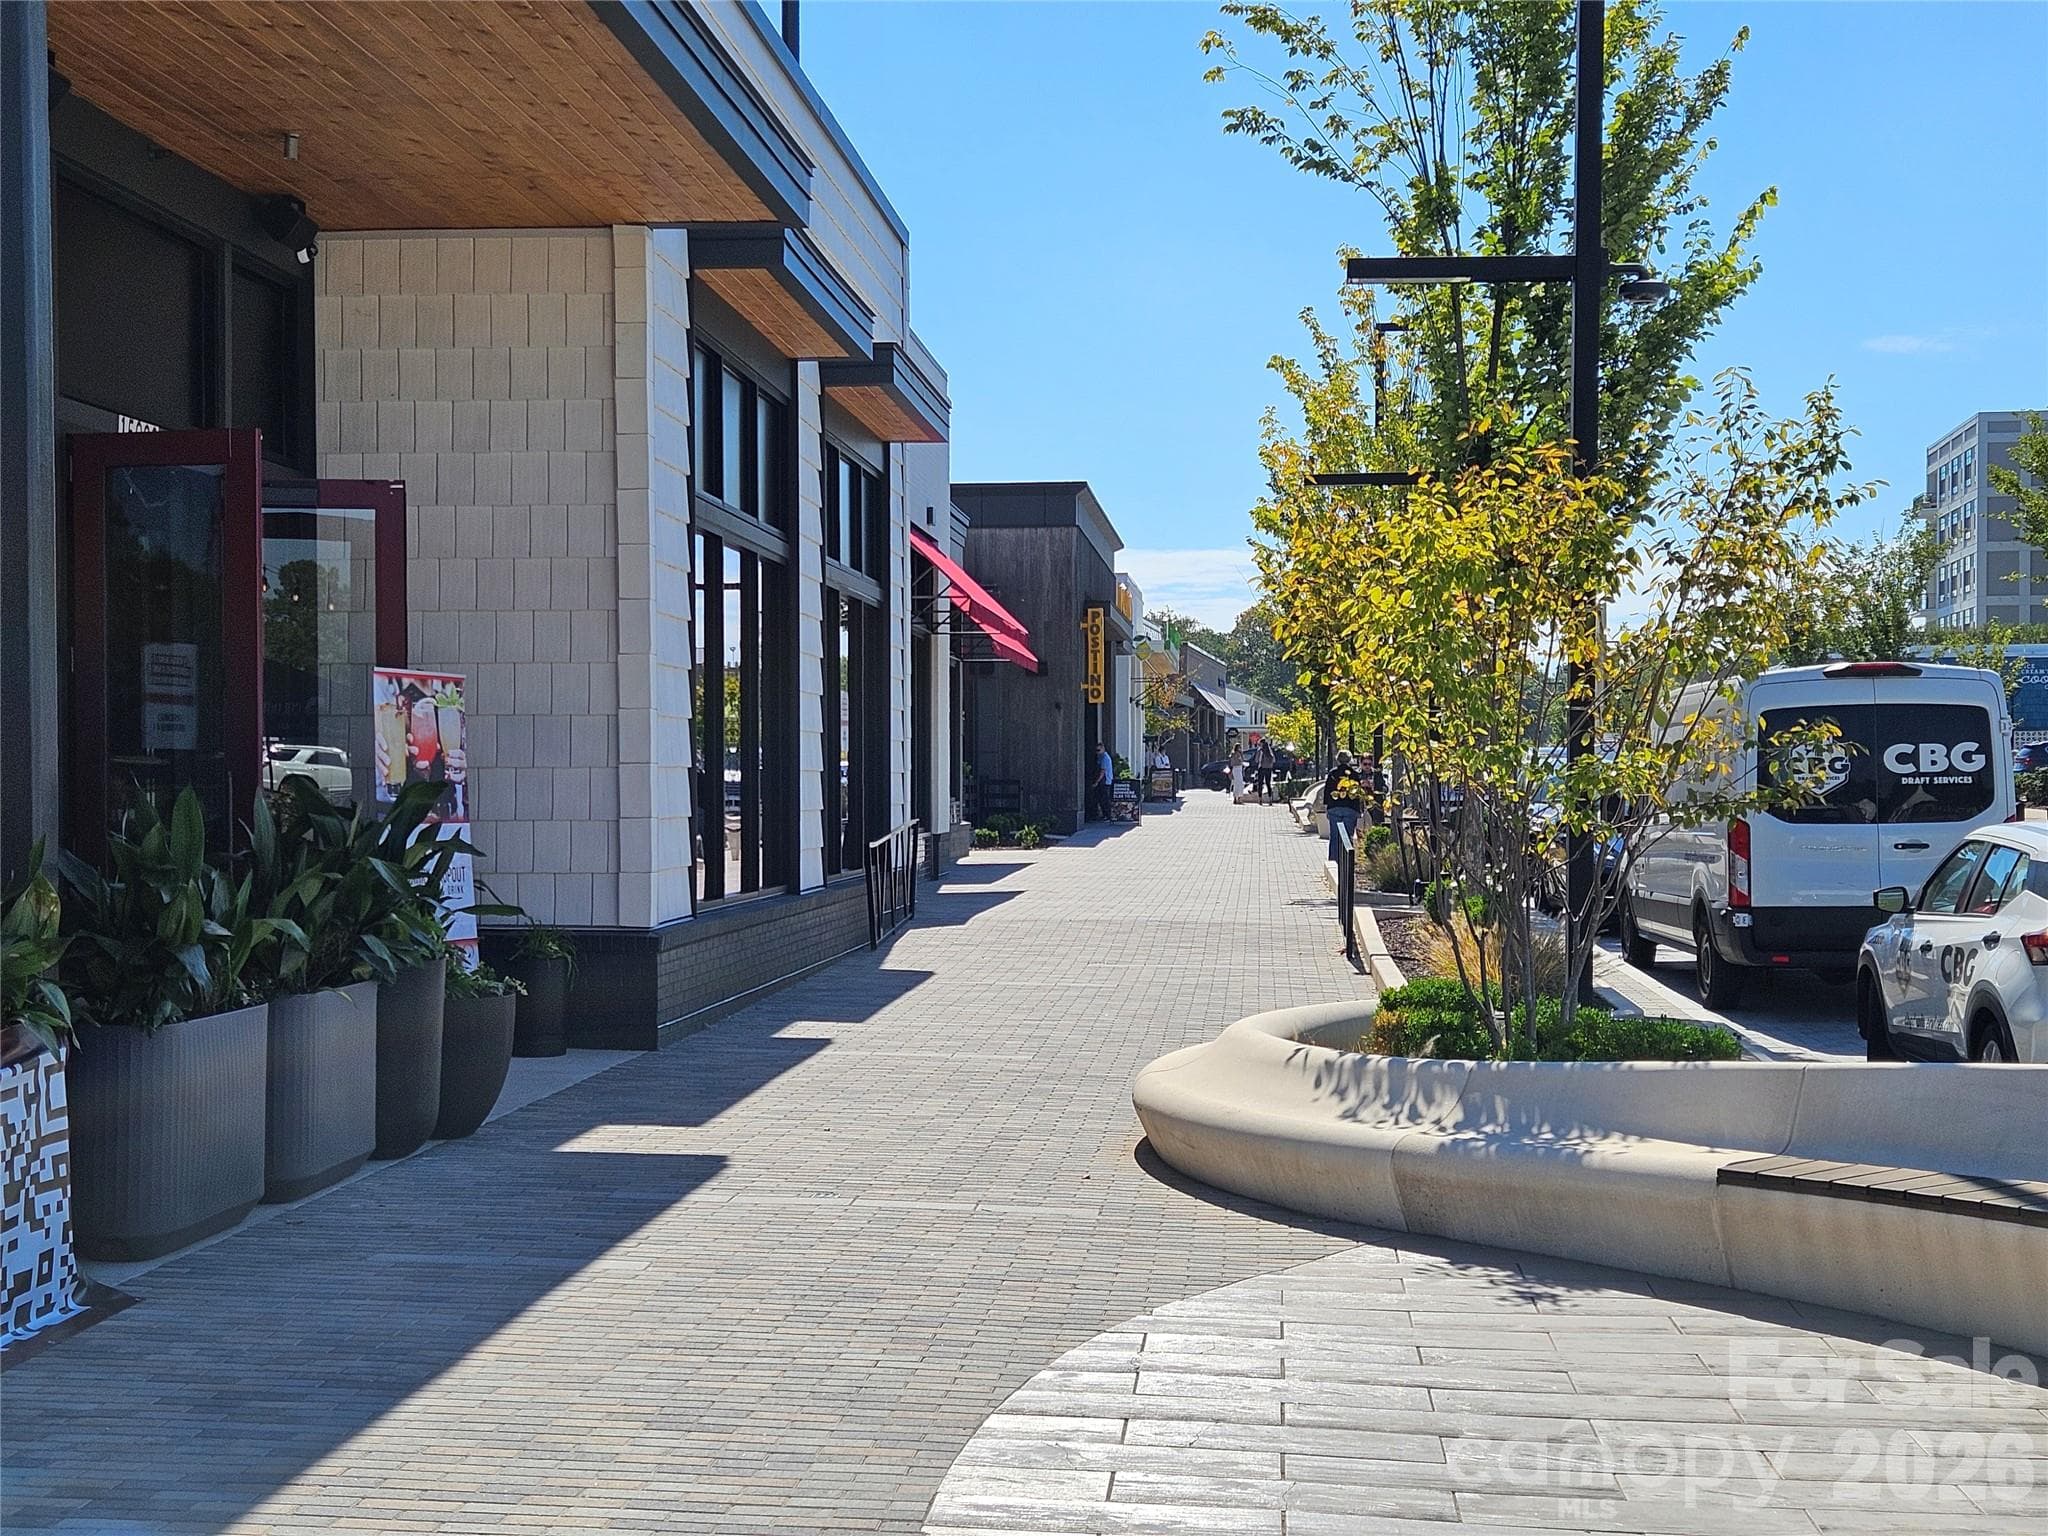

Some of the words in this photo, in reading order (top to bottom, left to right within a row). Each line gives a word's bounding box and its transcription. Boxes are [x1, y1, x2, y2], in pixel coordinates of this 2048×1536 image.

[1089, 610, 1102, 700] POSTINO
[1883, 741, 1987, 774] CBG
[1901, 777, 1930, 785] DRAFT
[1933, 776, 1973, 784] SERVICES
[1941, 945, 1979, 986] CBG
